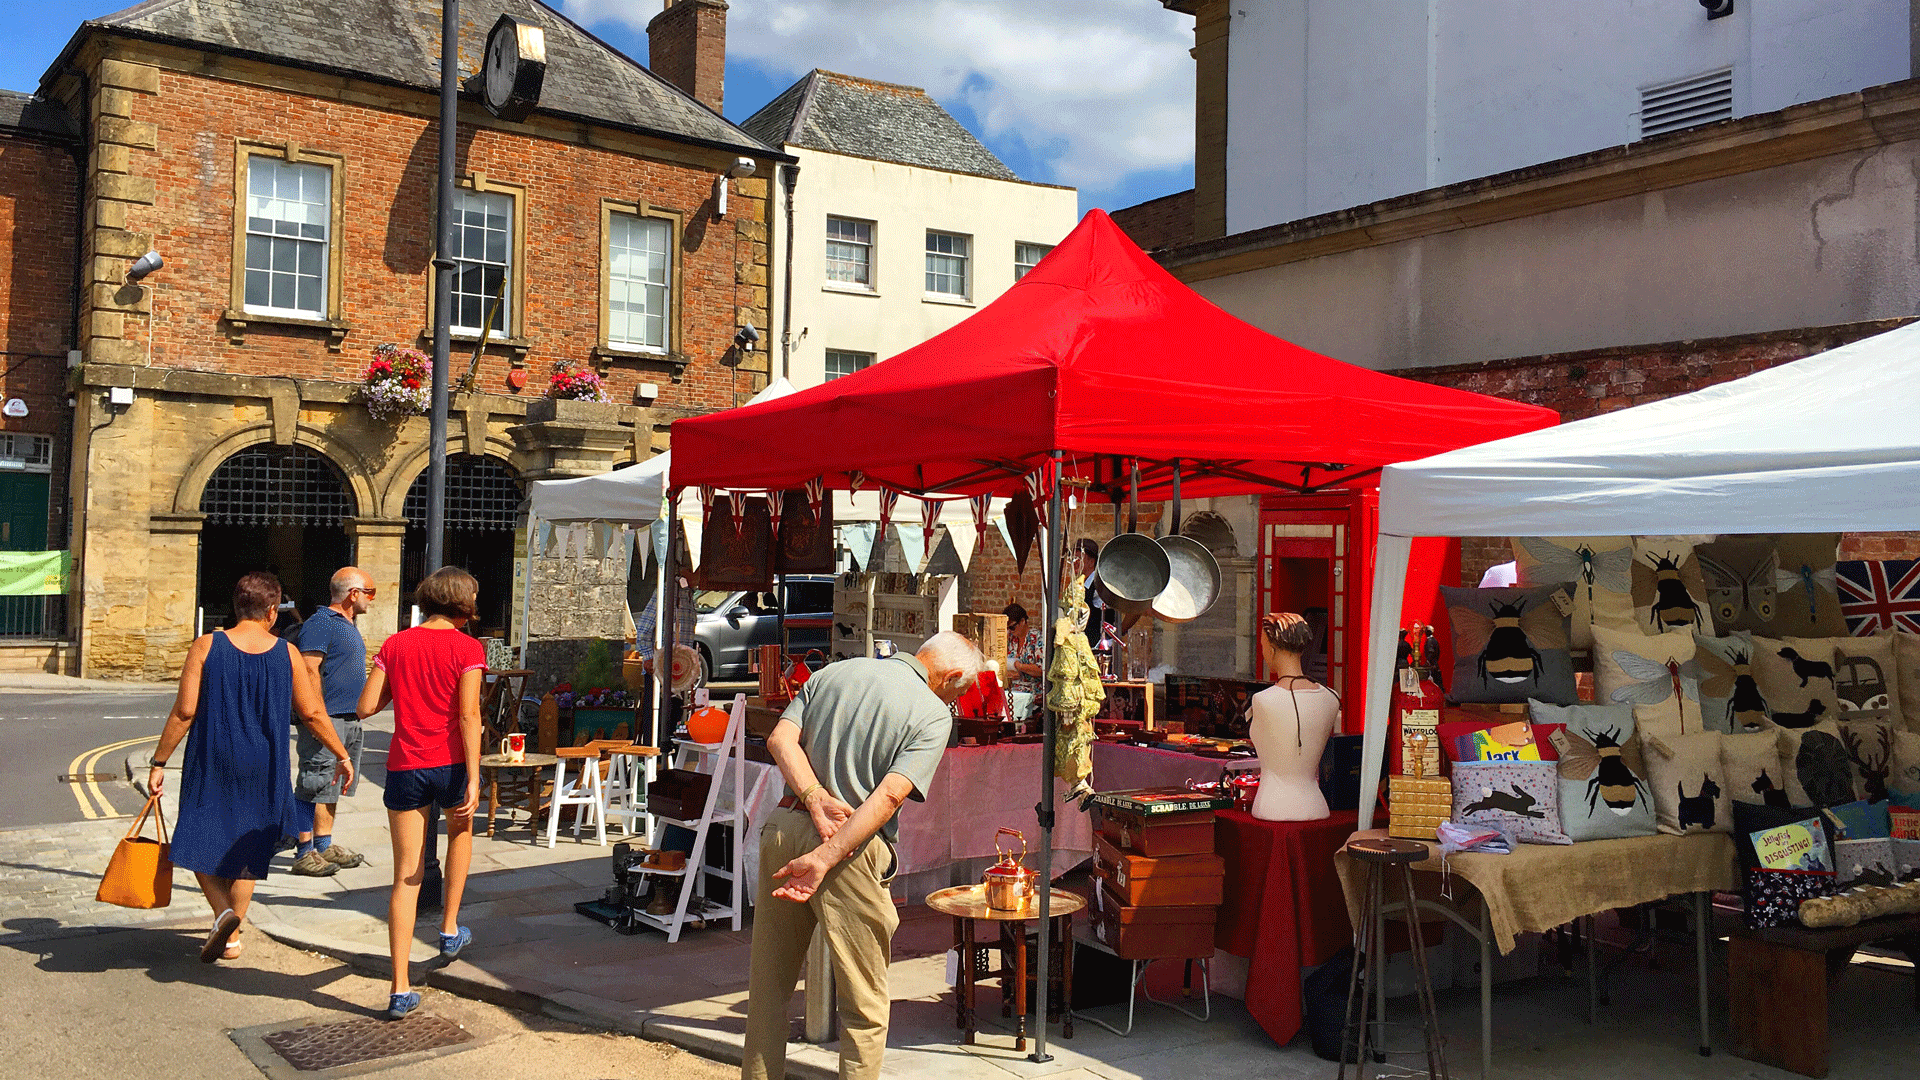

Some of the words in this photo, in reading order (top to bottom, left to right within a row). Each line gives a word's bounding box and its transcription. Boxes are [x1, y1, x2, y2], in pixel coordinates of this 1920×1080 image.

[1151, 803, 1187, 813] SCRABBLE
[1762, 829, 1791, 847] Jellyfish
[1764, 838, 1811, 864] DISGUSTING!
